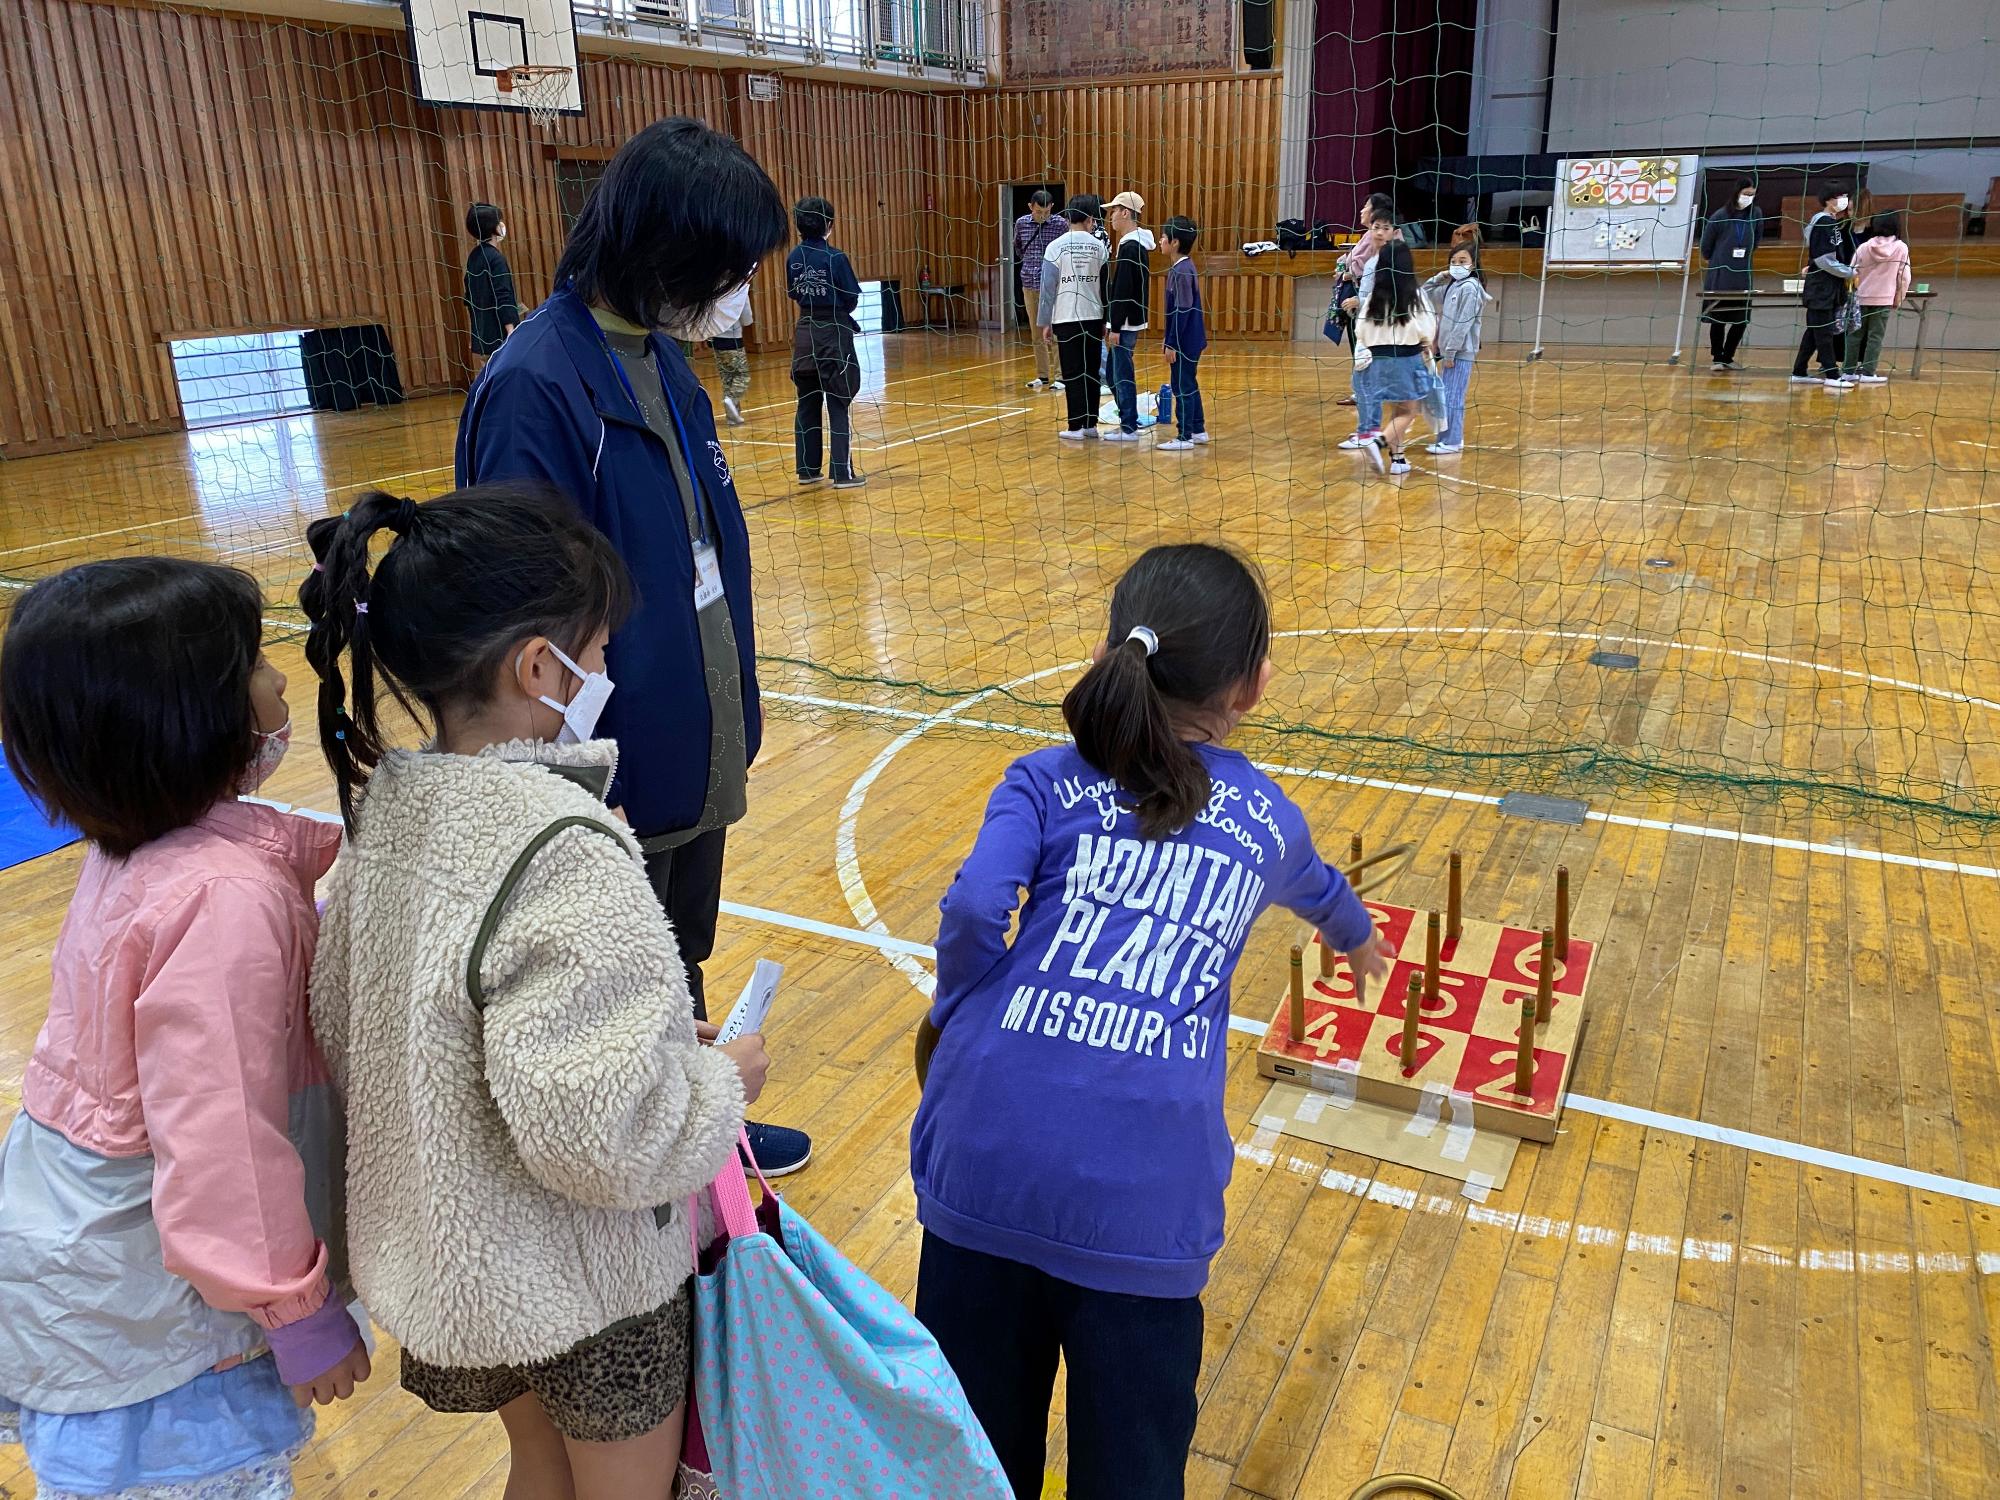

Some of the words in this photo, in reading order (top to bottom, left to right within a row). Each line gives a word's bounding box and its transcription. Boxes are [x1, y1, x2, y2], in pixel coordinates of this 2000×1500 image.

[1575, 164, 1640, 184] フリー
[1609, 183, 1674, 201] スロー
[1062, 275, 1076, 284] RAT
[1061, 833, 1265, 951] MOUNTAIN
[1038, 896, 1227, 1008] PLANTS
[1514, 940, 1568, 982] 6
[1401, 970, 1466, 1020] 5
[1000, 985, 1172, 1060] MISSOURI
[1182, 1013, 1211, 1060] 37
[1288, 1010, 1342, 1058] 4
[1474, 1050, 1540, 1107] 2
